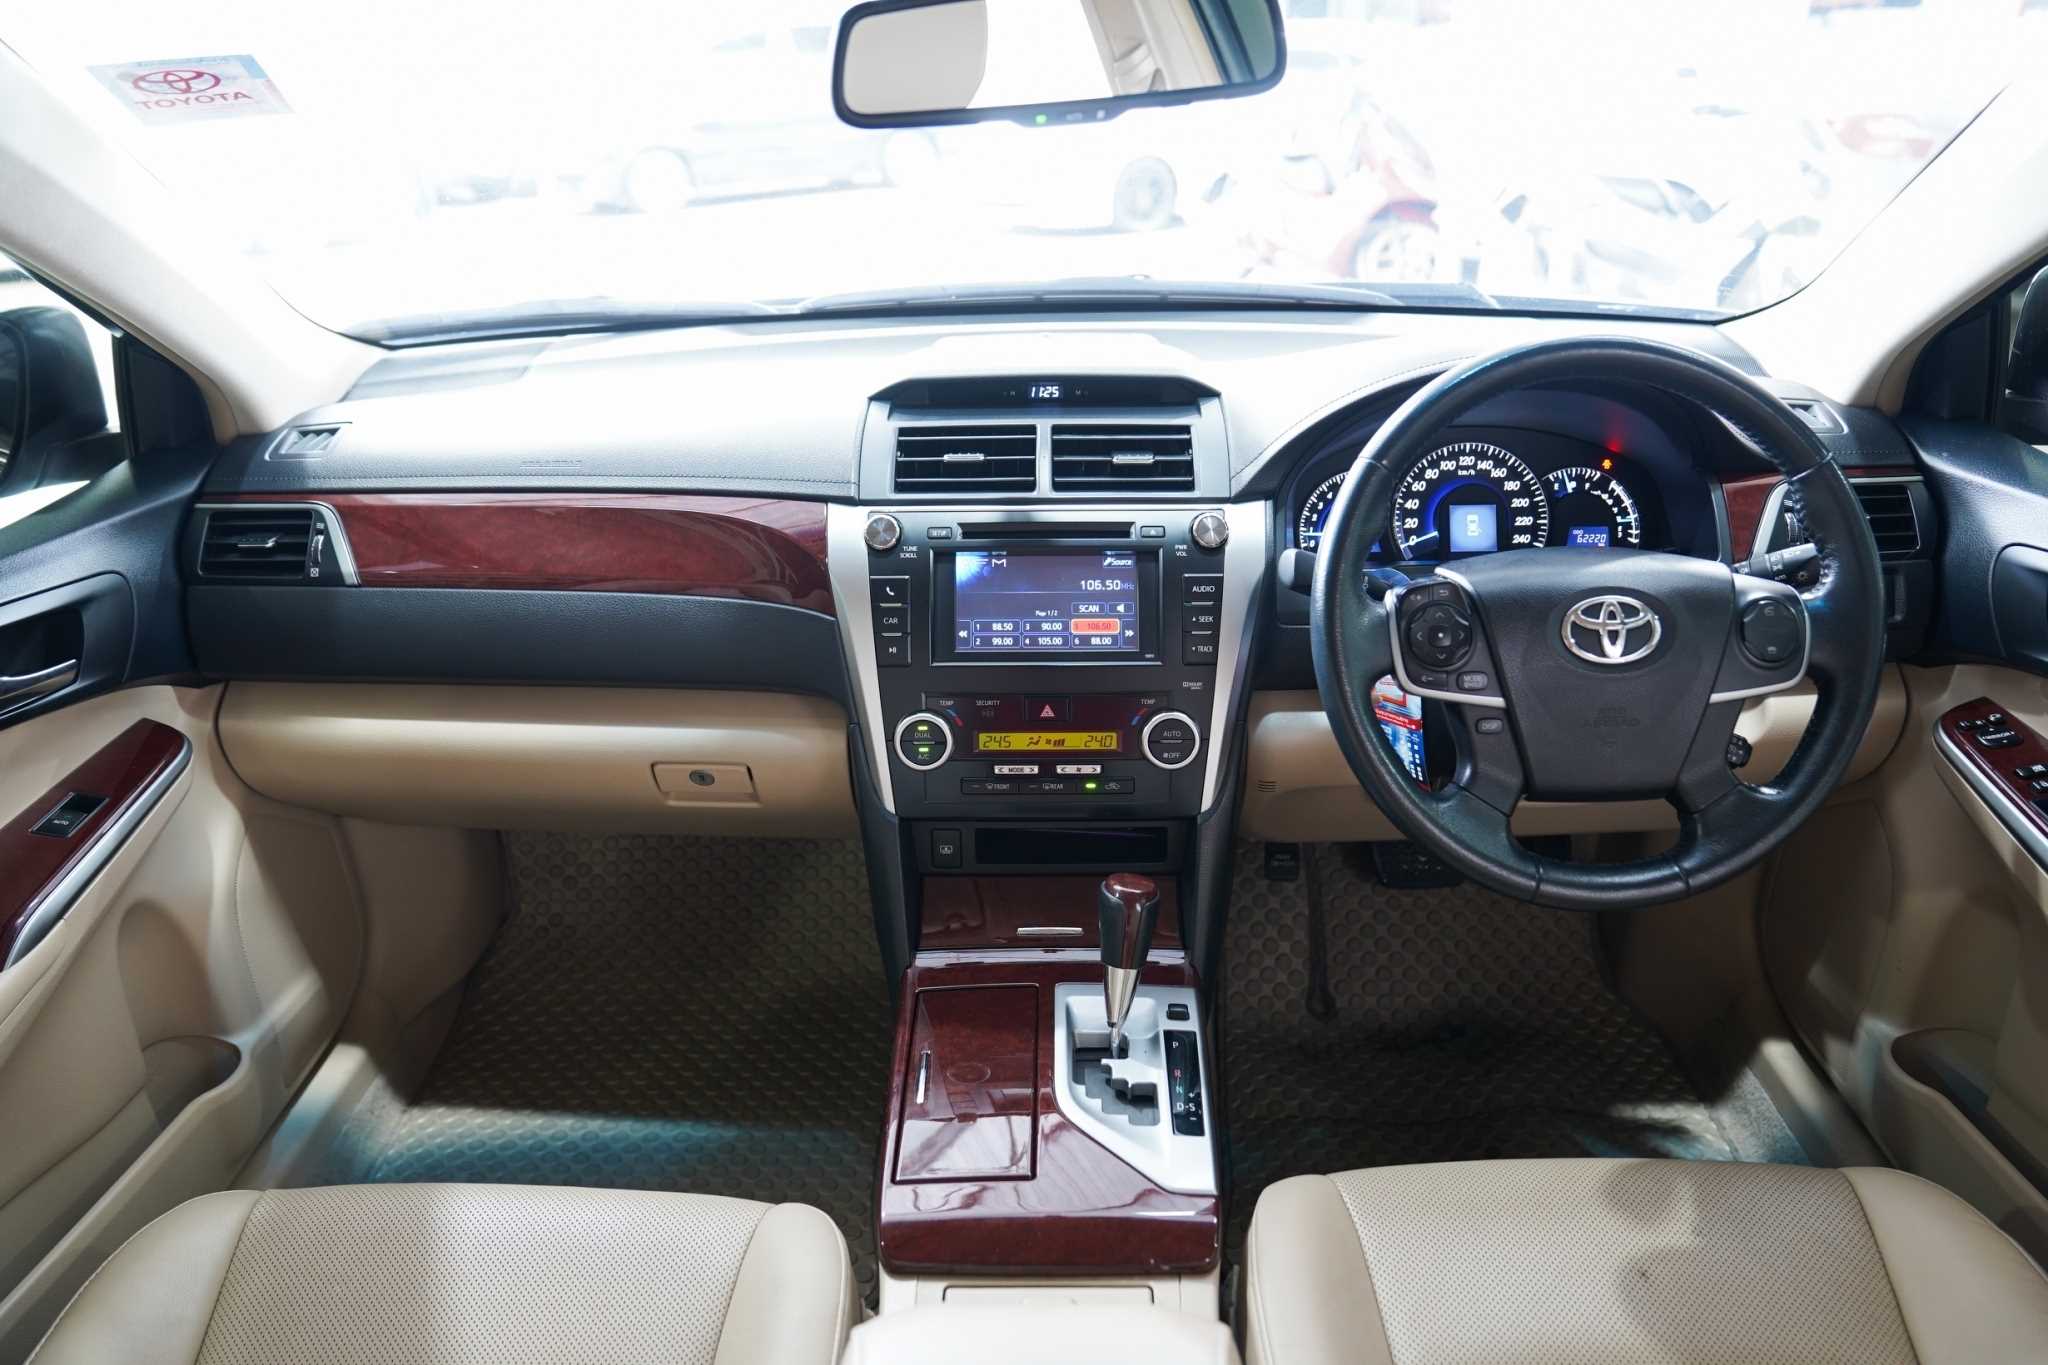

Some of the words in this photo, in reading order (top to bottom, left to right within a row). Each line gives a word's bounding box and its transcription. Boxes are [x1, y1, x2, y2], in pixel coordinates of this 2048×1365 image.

[135, 91, 253, 110] TOYOTA
[1440, 461, 1456, 471] 100
[1459, 456, 1475, 466] 120
[1477, 460, 1493, 470] 140
[1424, 468, 1439, 479] 80
[1490, 468, 1507, 478] 160
[1411, 481, 1426, 491] 60
[1503, 481, 1520, 491] 180
[1404, 499, 1419, 509] 40
[1510, 498, 1529, 507] 200
[1404, 518, 1418, 529] 20
[1514, 516, 1533, 526] 220
[1512, 534, 1531, 544] 240
[1577, 534, 1607, 543] 62220
[1080, 580, 1121, 590] 106.50
[1079, 604, 1099, 613] SCAN
[1041, 623, 1062, 631] 90.00
[992, 637, 1013, 645] 99.00
[1038, 637, 1062, 645] 105.00
[1091, 637, 1112, 645] 88.00
